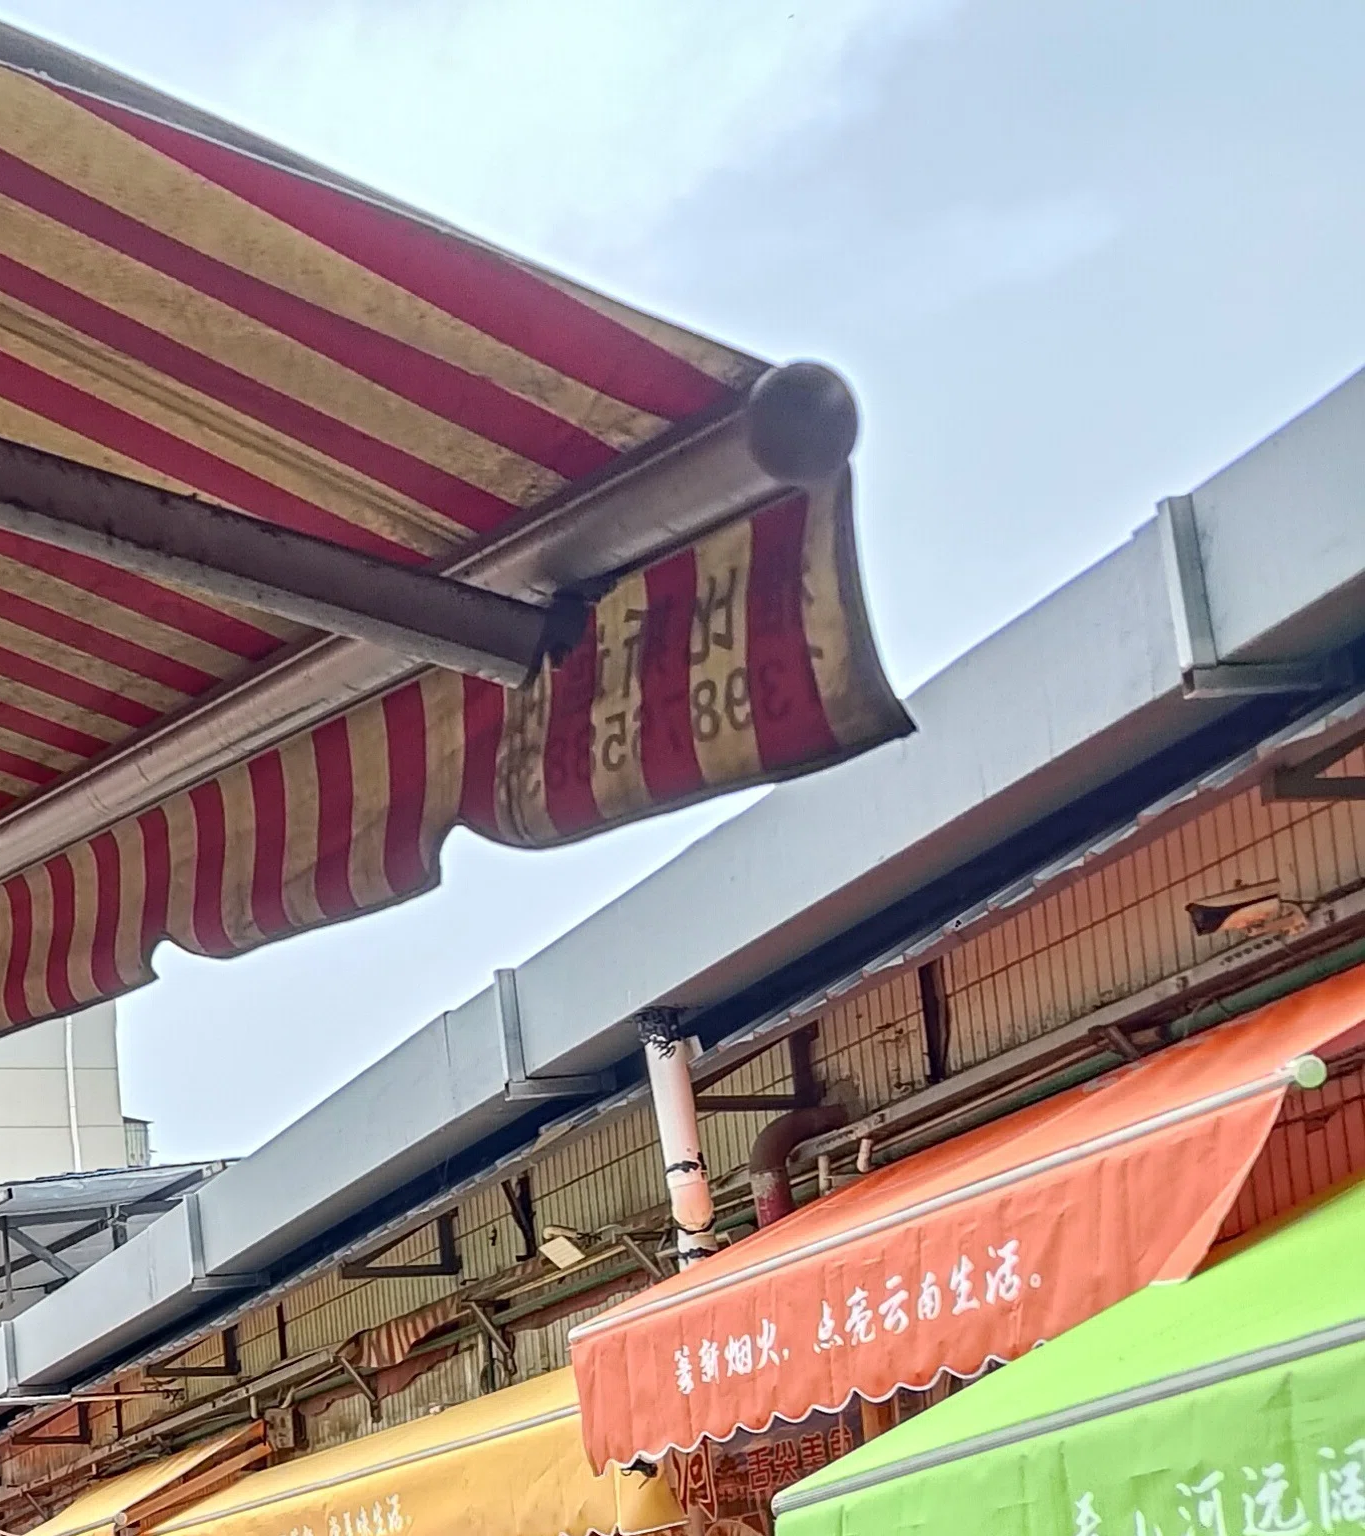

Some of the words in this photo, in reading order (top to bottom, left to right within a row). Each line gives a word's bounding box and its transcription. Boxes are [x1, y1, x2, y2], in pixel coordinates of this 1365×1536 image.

[672, 1237, 1043, 1396] 篆新烟火，点亮云南生活。
